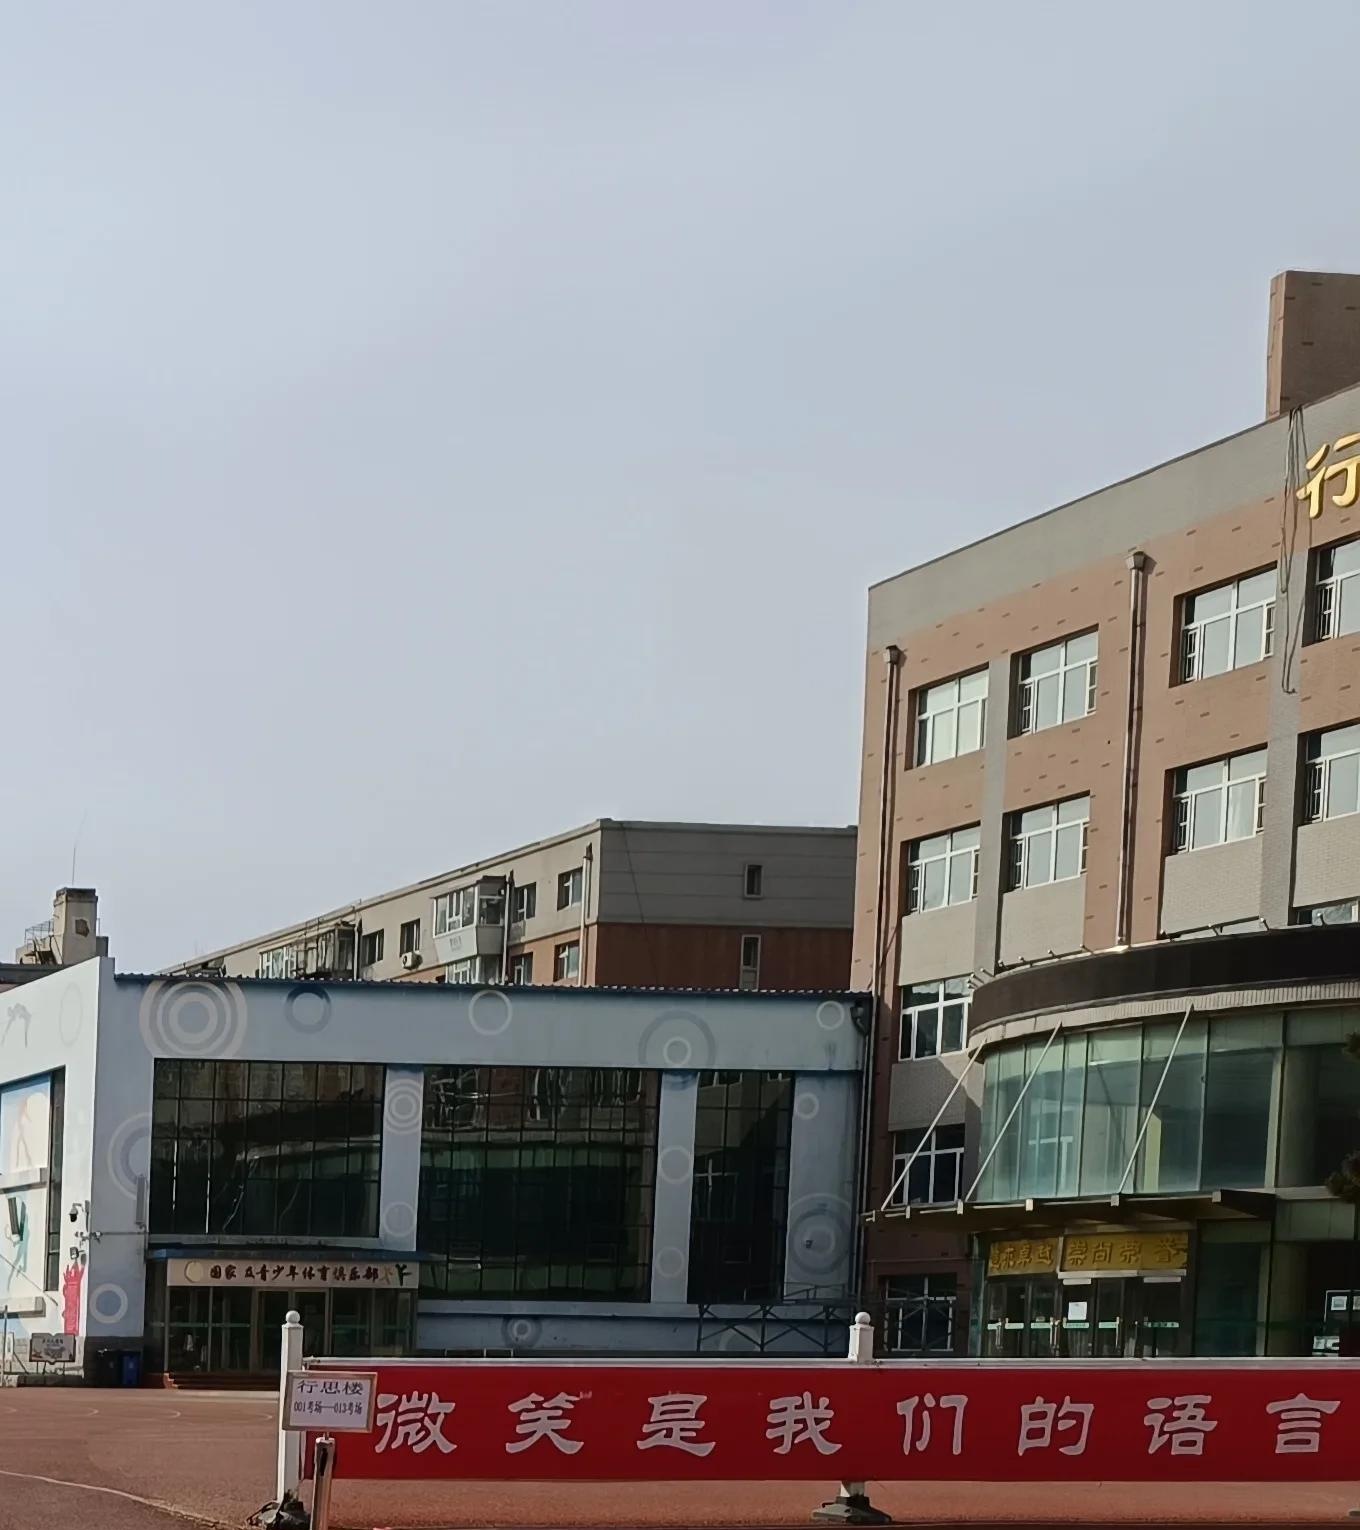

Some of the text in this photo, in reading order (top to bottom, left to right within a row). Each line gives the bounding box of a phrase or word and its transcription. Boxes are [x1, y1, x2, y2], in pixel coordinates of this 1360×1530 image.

[1296, 432, 1360, 519] 行
[297, 1380, 364, 1395] 行思楼
[375, 1391, 1340, 1456] 微笑是我们的语言
